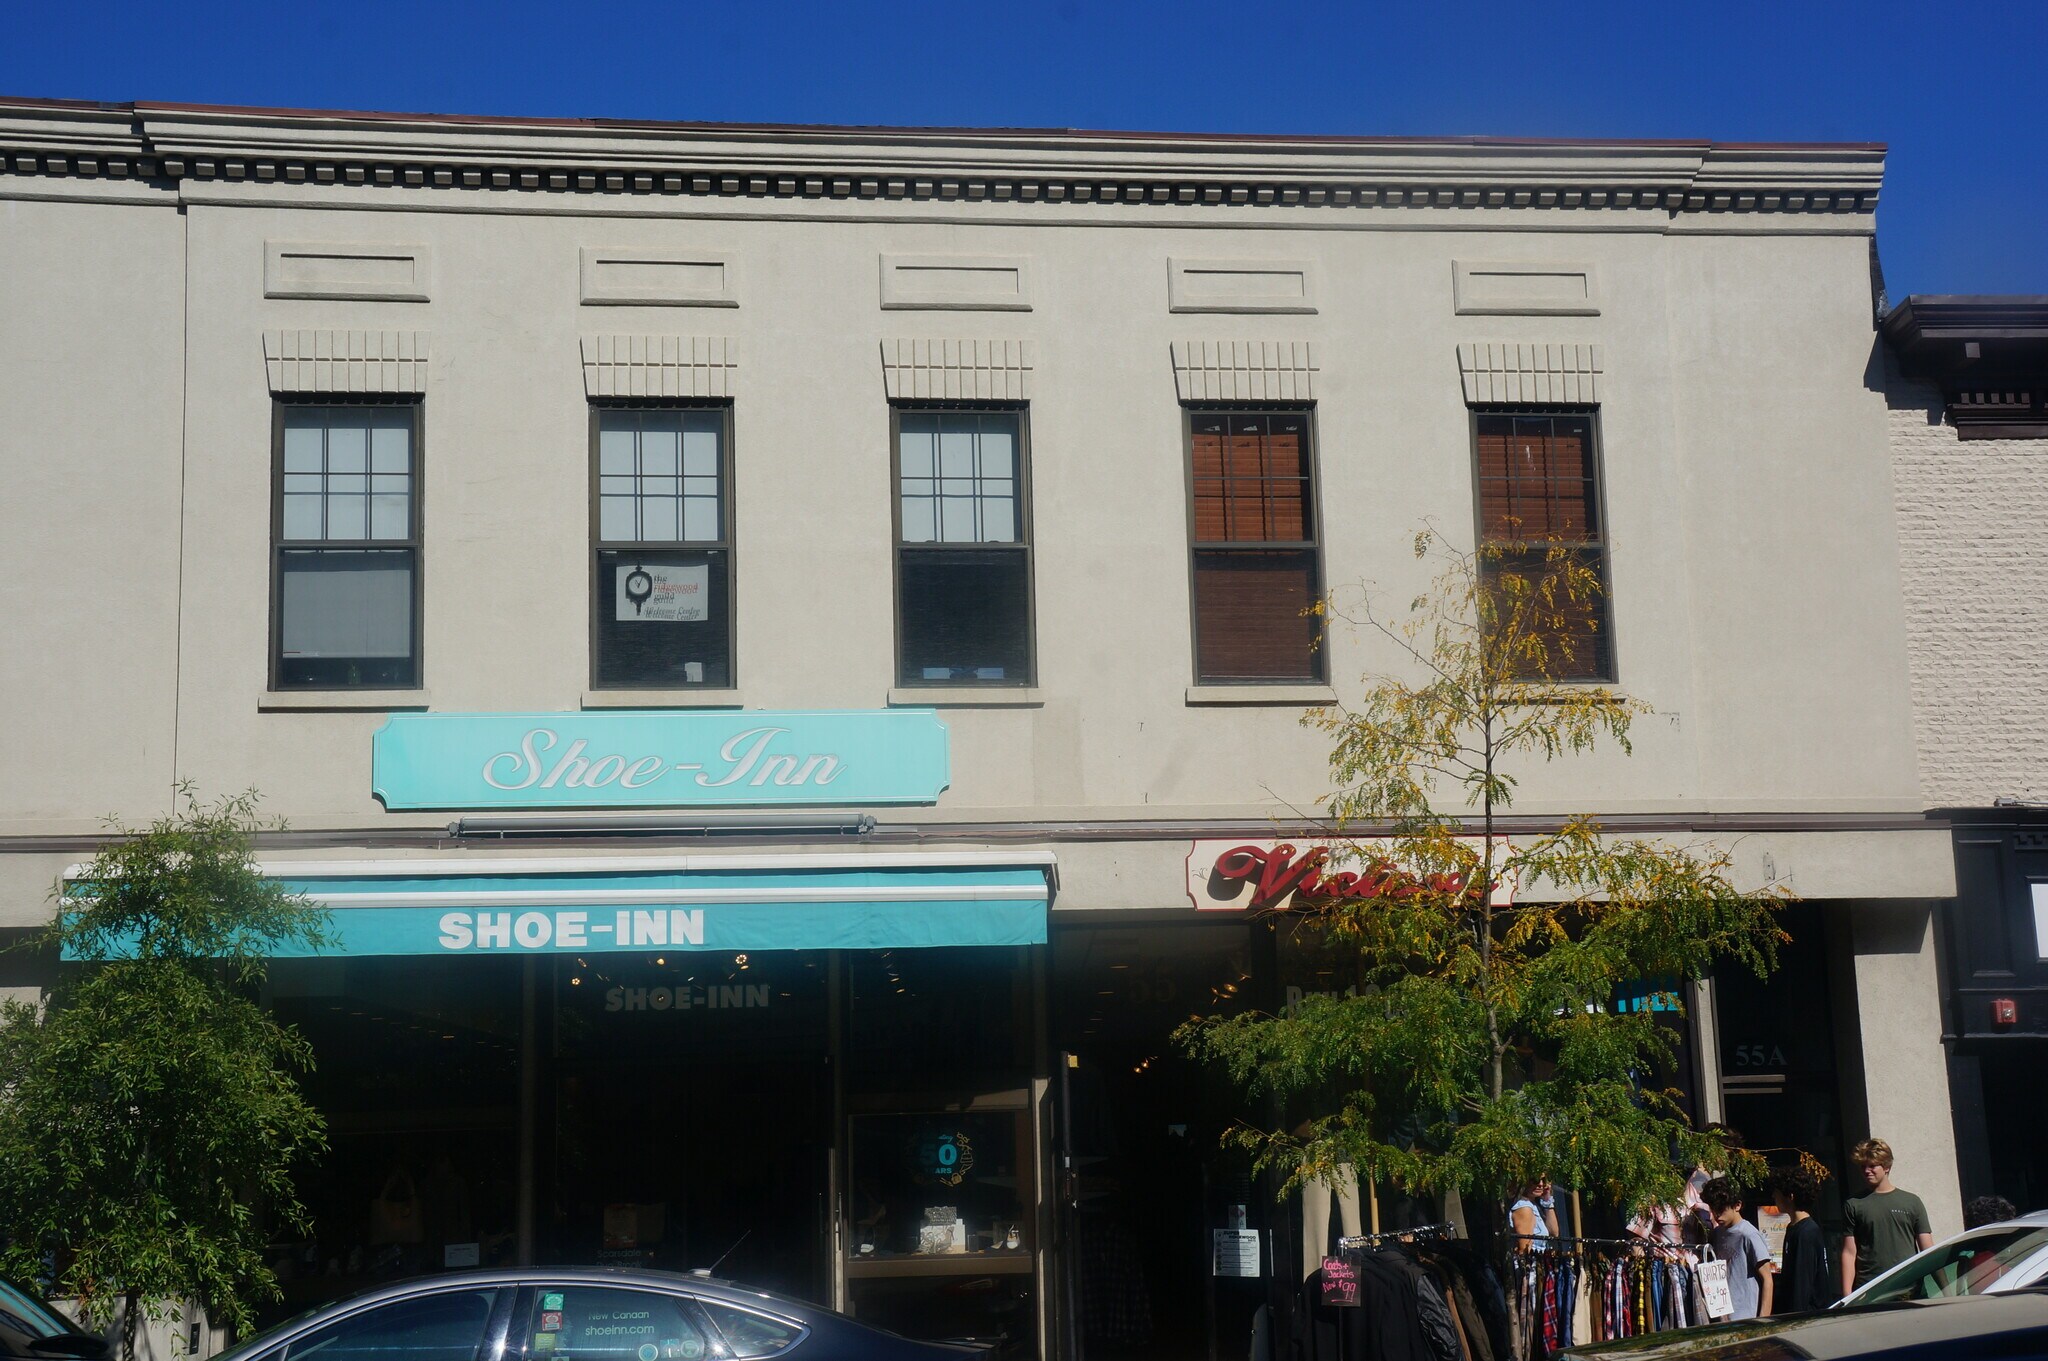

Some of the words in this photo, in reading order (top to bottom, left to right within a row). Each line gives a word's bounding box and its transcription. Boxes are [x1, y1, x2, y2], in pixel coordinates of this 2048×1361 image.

[482, 727, 848, 790] Shoe-Inn
[438, 909, 704, 949] SHOE-INN
[605, 984, 769, 1011] SHOE-INN
[1736, 1045, 1788, 1066] 55A
[597, 1248, 641, 1258] Scarsdale
[588, 1312, 609, 1321] New
[612, 1311, 650, 1320] Canaan
[585, 1324, 655, 1336] shoeinn.com
